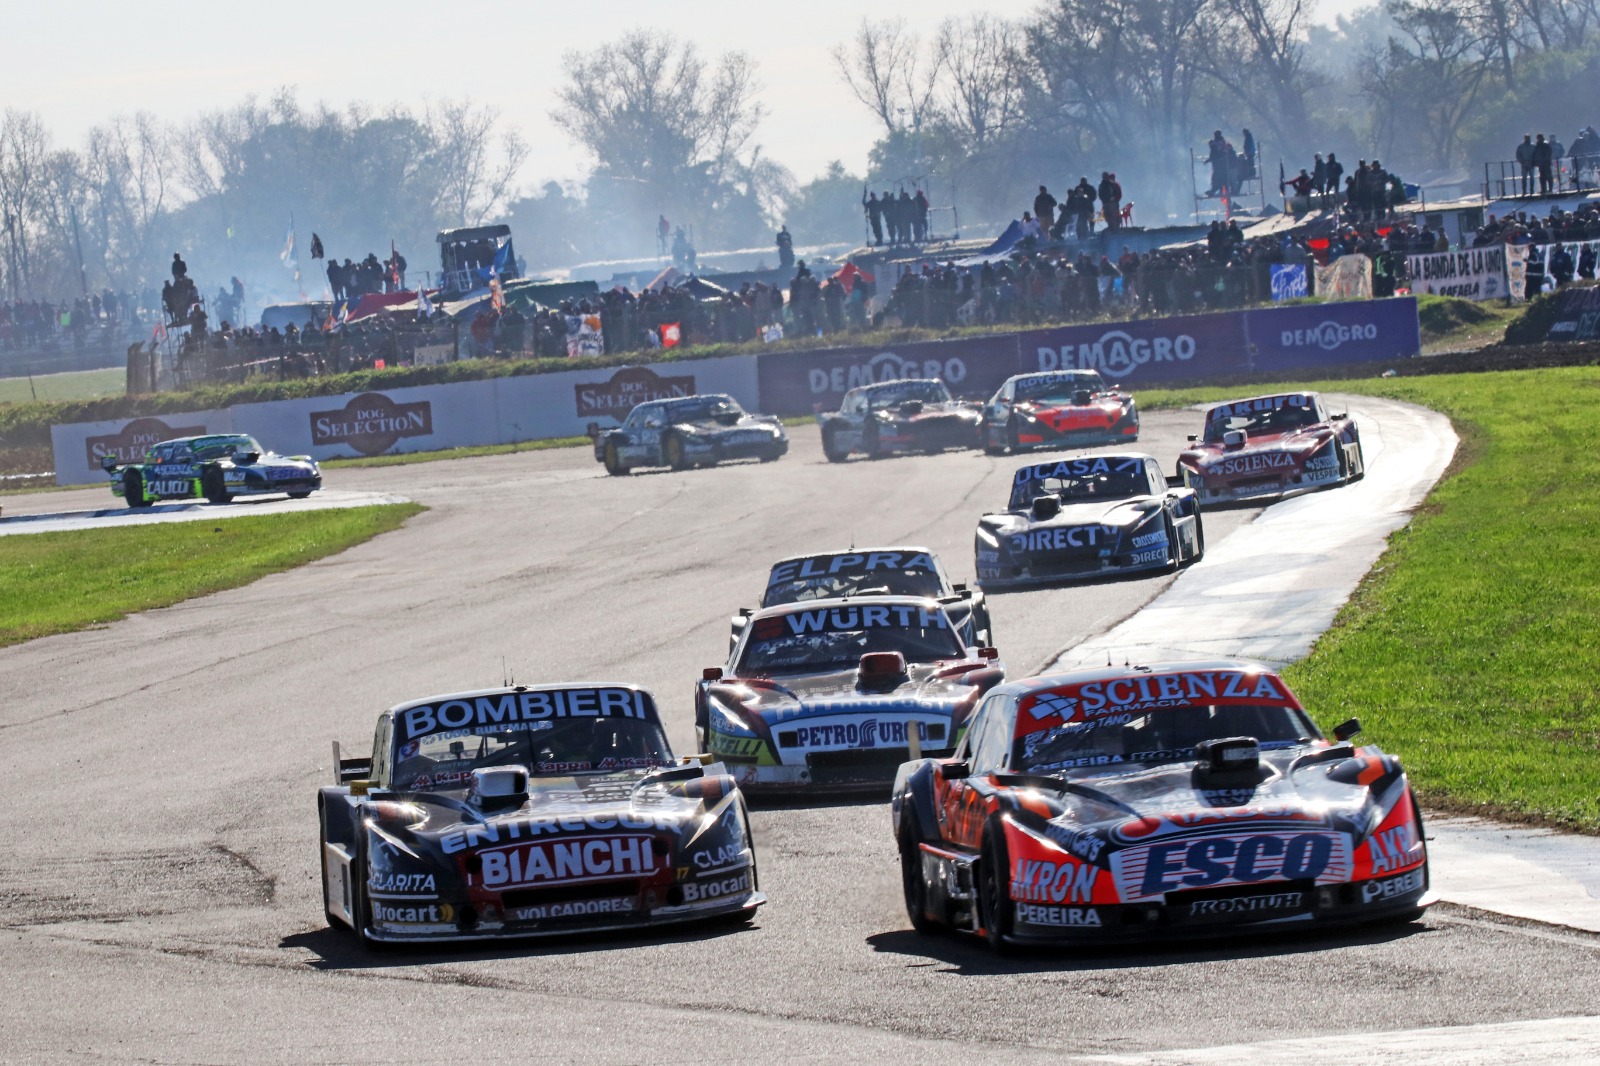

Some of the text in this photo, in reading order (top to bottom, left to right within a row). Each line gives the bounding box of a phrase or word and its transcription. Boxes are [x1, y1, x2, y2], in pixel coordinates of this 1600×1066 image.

[1423, 254, 1457, 279] BANDA
[1458, 252, 1470, 276] DE
[1471, 250, 1484, 274] LA
[1281, 322, 1377, 348] DEMAGRO
[1038, 332, 1196, 374] DEMAGRO
[809, 355, 967, 393] DEMAGRO
[317, 411, 424, 438] SELECTION
[357, 408, 385, 420] DOG
[133, 434, 160, 444] DOG
[92, 441, 152, 463] SELEC
[1226, 453, 1295, 474] SCIENZA
[769, 553, 937, 588] ELPRA
[786, 606, 947, 635] WÜRTH
[1080, 672, 1284, 710] SCIENZA
[404, 689, 646, 739] BOMBIERI
[1084, 698, 1192, 717] FARMACIA
[436, 720, 554, 742] TODO RULEMANES
[797, 724, 858, 747] PETRO
[435, 771, 472, 784] Kap
[538, 761, 591, 773] Kappa
[481, 838, 655, 886] BIANCHI
[676, 866, 690, 880] 17
[1140, 833, 1332, 895] ESCO
[369, 873, 436, 892] CLARITA
[1010, 858, 1100, 903] AKRON
[374, 901, 439, 923] Brocart
[516, 897, 633, 920] VOLCADORES
[1016, 903, 1101, 924] PEREIRA
